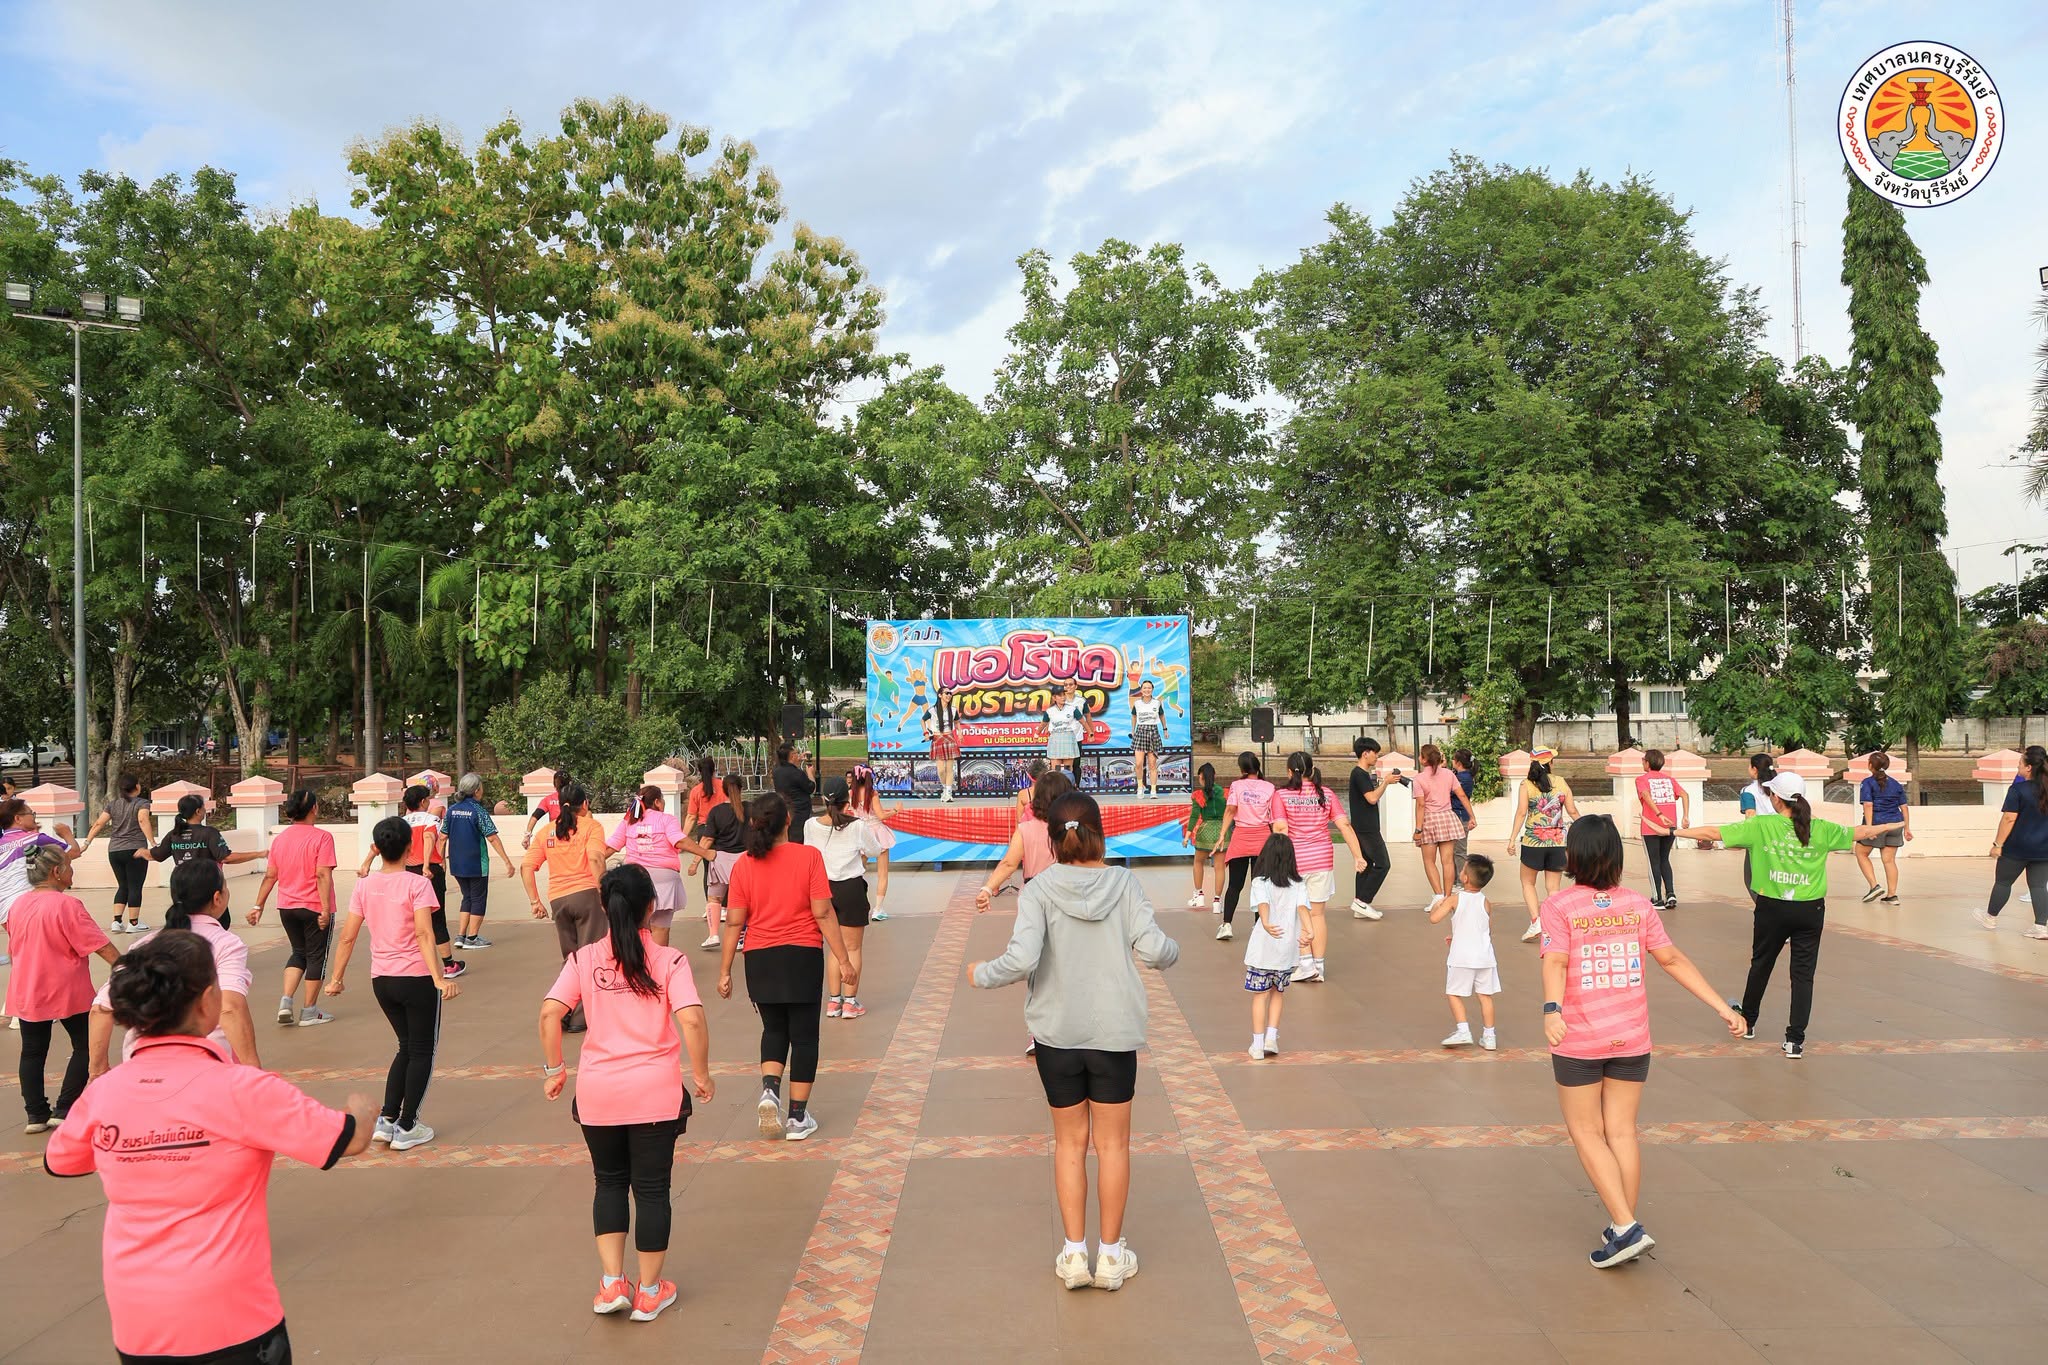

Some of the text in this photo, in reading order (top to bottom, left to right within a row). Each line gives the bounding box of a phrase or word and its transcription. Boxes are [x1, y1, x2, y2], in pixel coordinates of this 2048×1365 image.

[939, 634, 1117, 690] แอโรบิค
[952, 688, 1105, 717] เซราะกว
[1012, 726, 1033, 735] เวลา
[1769, 870, 1811, 885] MEDICAL
